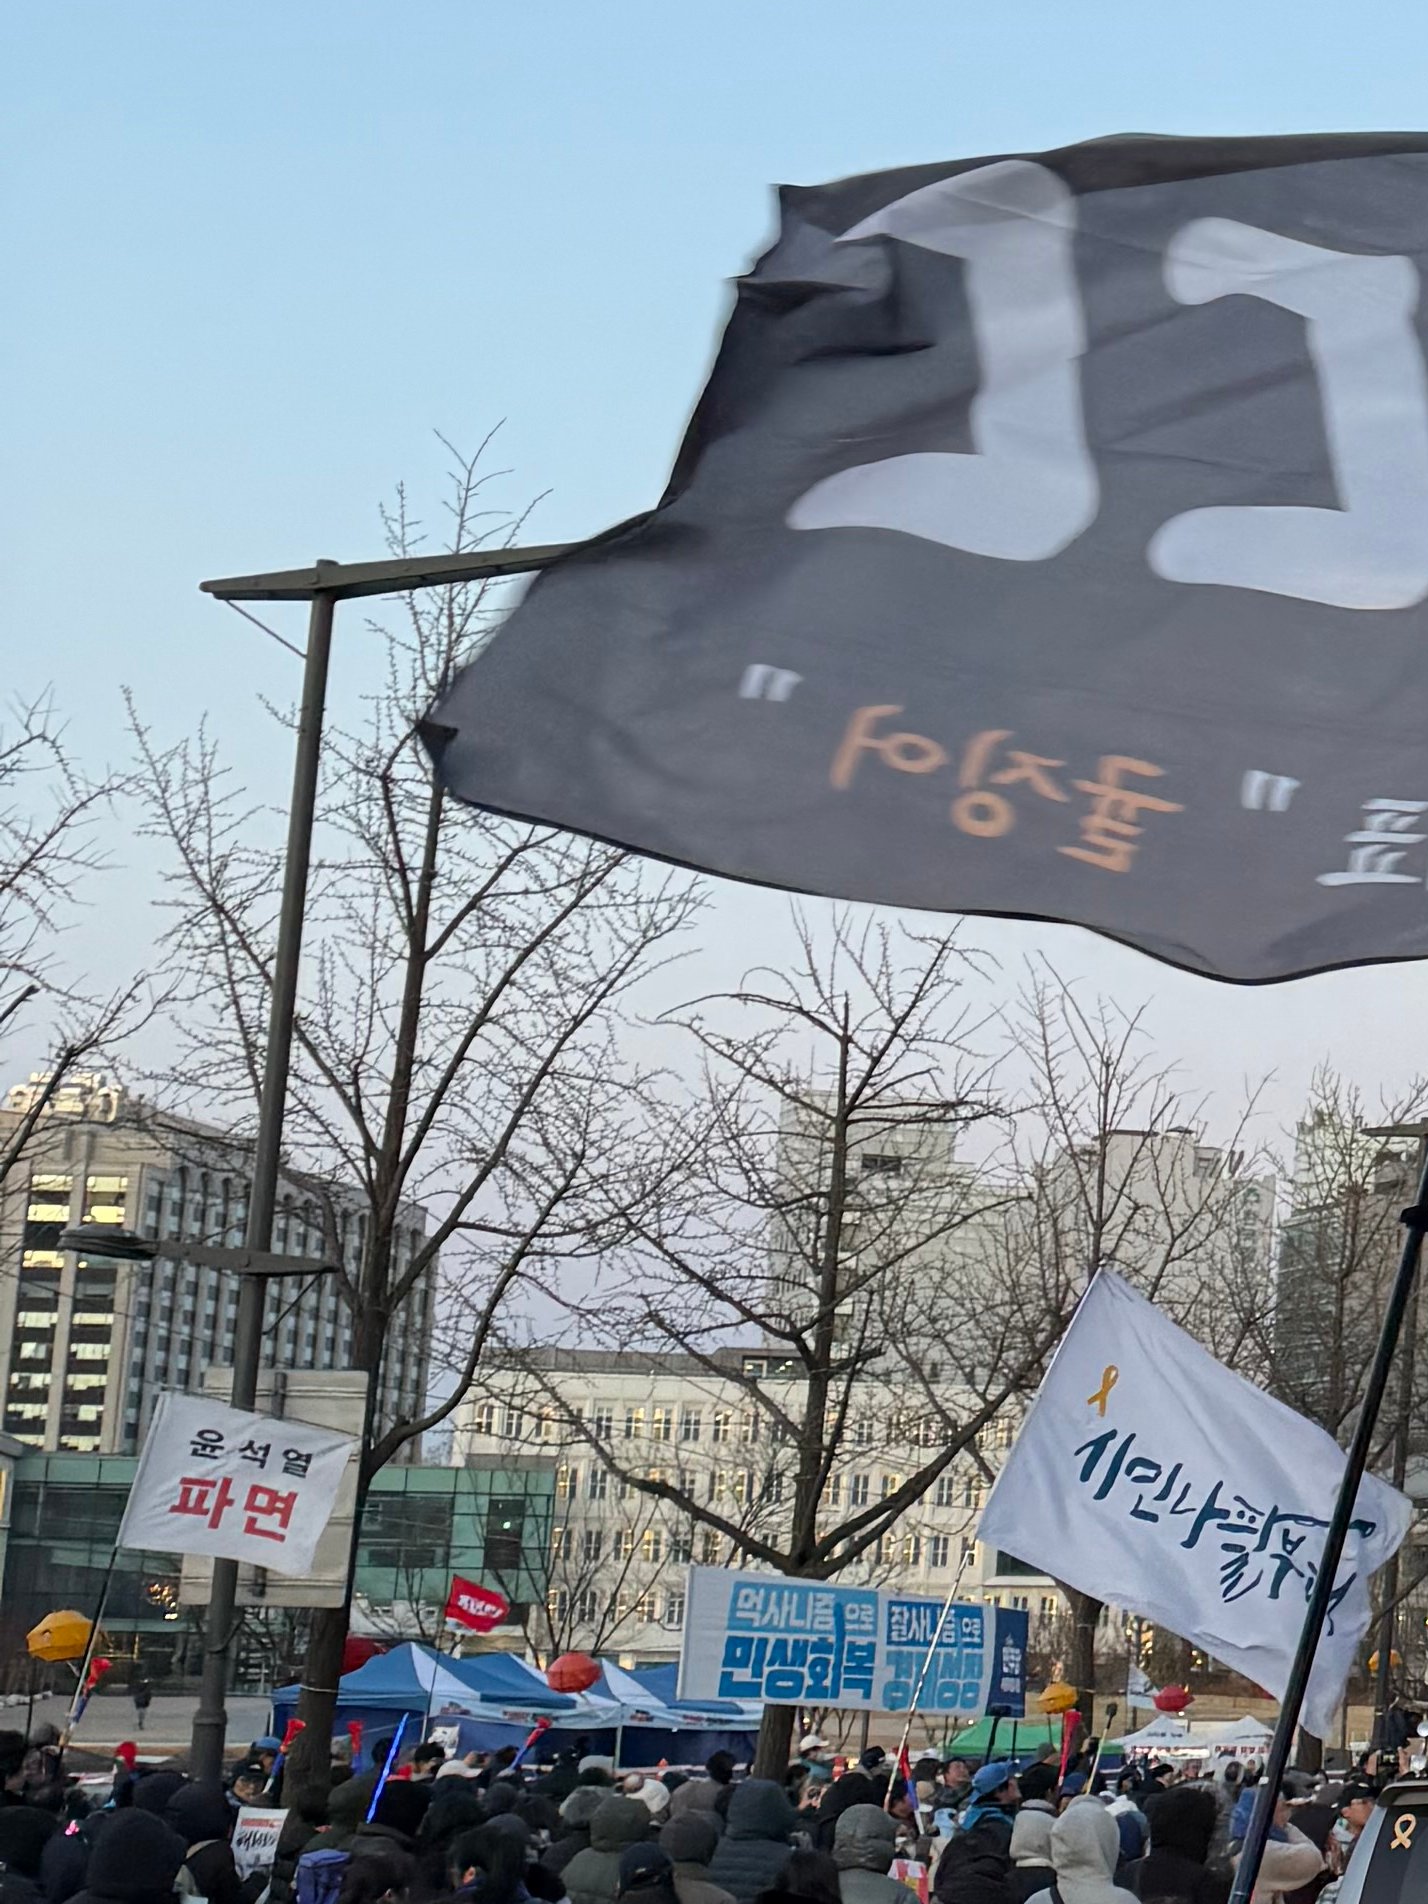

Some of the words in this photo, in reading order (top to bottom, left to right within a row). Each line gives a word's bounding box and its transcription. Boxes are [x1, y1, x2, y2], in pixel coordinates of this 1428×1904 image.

[190, 1429, 313, 1479] 윤석열
[168, 1477, 298, 1543] 파면
[718, 1635, 877, 1700] 민생회복
